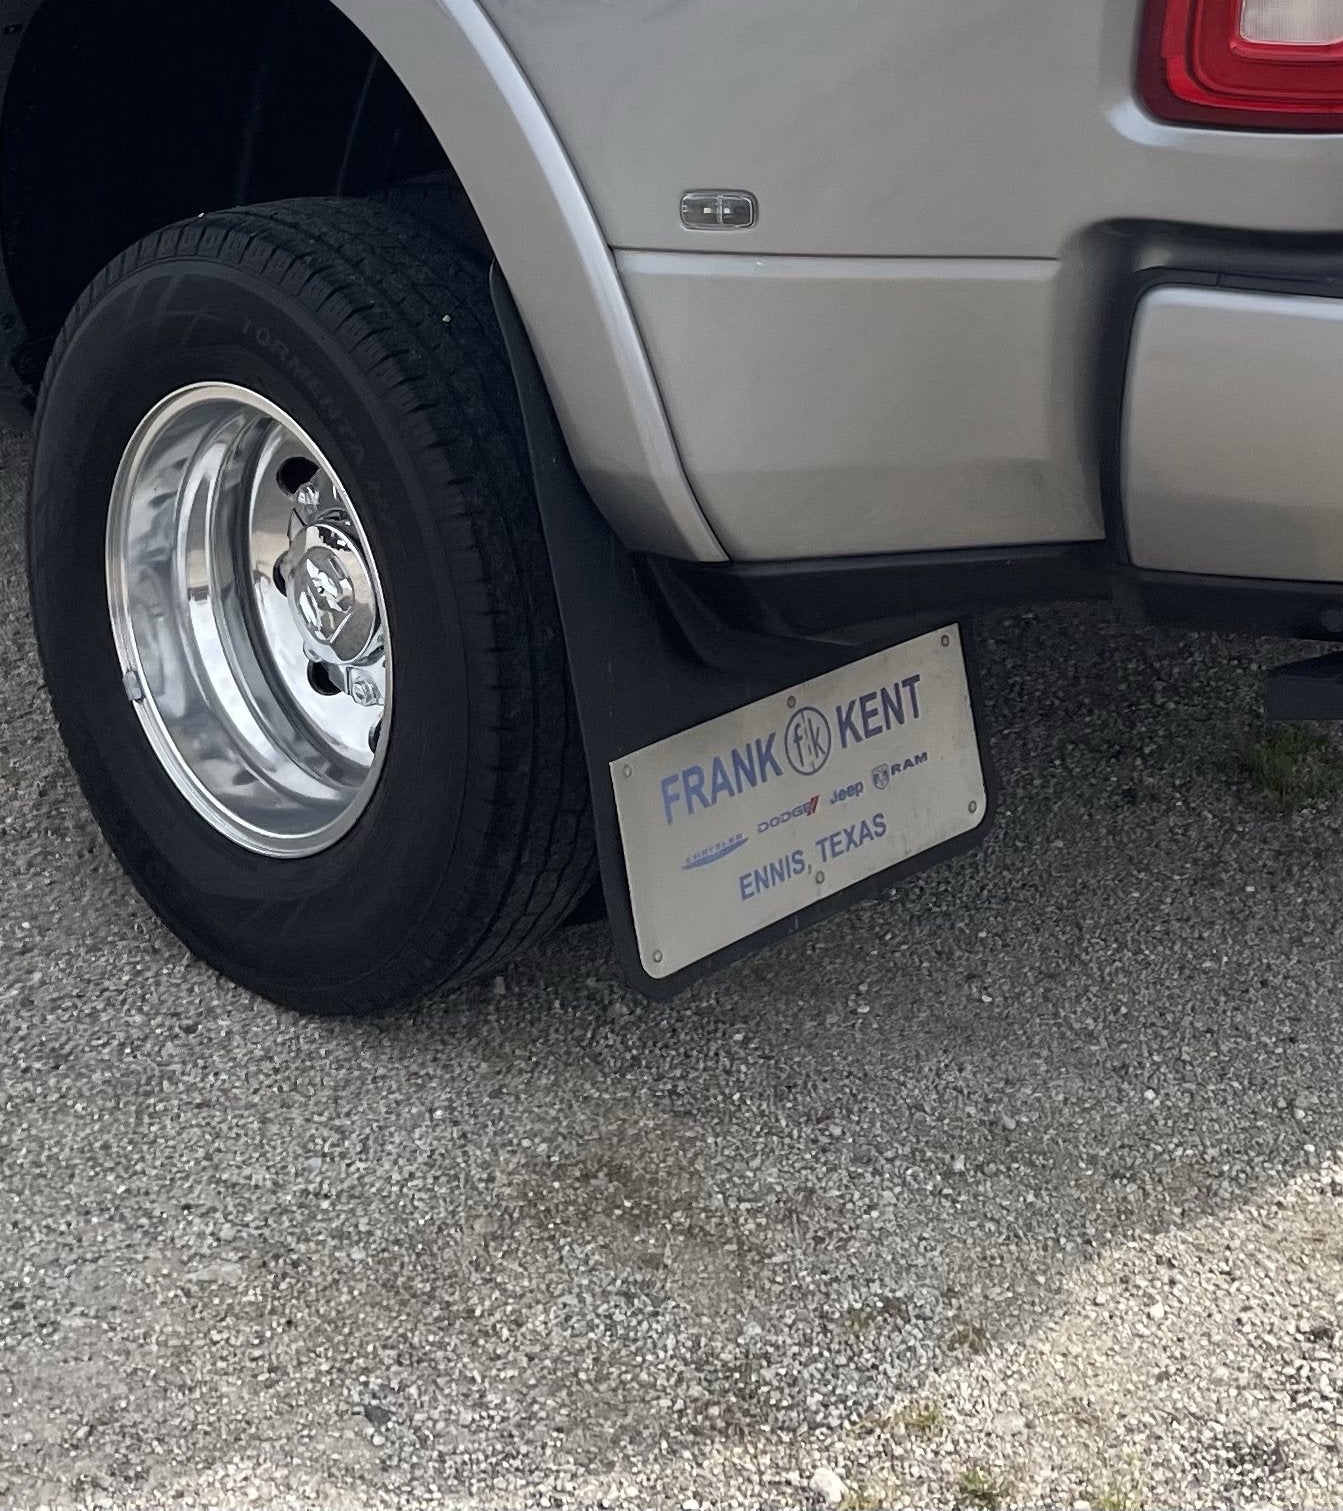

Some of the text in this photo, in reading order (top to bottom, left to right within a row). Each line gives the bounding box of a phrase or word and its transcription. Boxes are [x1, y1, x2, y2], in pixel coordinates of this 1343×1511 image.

[240, 317, 366, 465] TORMENTA
[661, 731, 783, 825] FRANK
[836, 674, 921, 749] KENT
[757, 801, 812, 834] DODGE
[830, 781, 865, 806] Jeep
[890, 751, 928, 777] RAM
[739, 812, 888, 901] ENNIS, TEXAS
